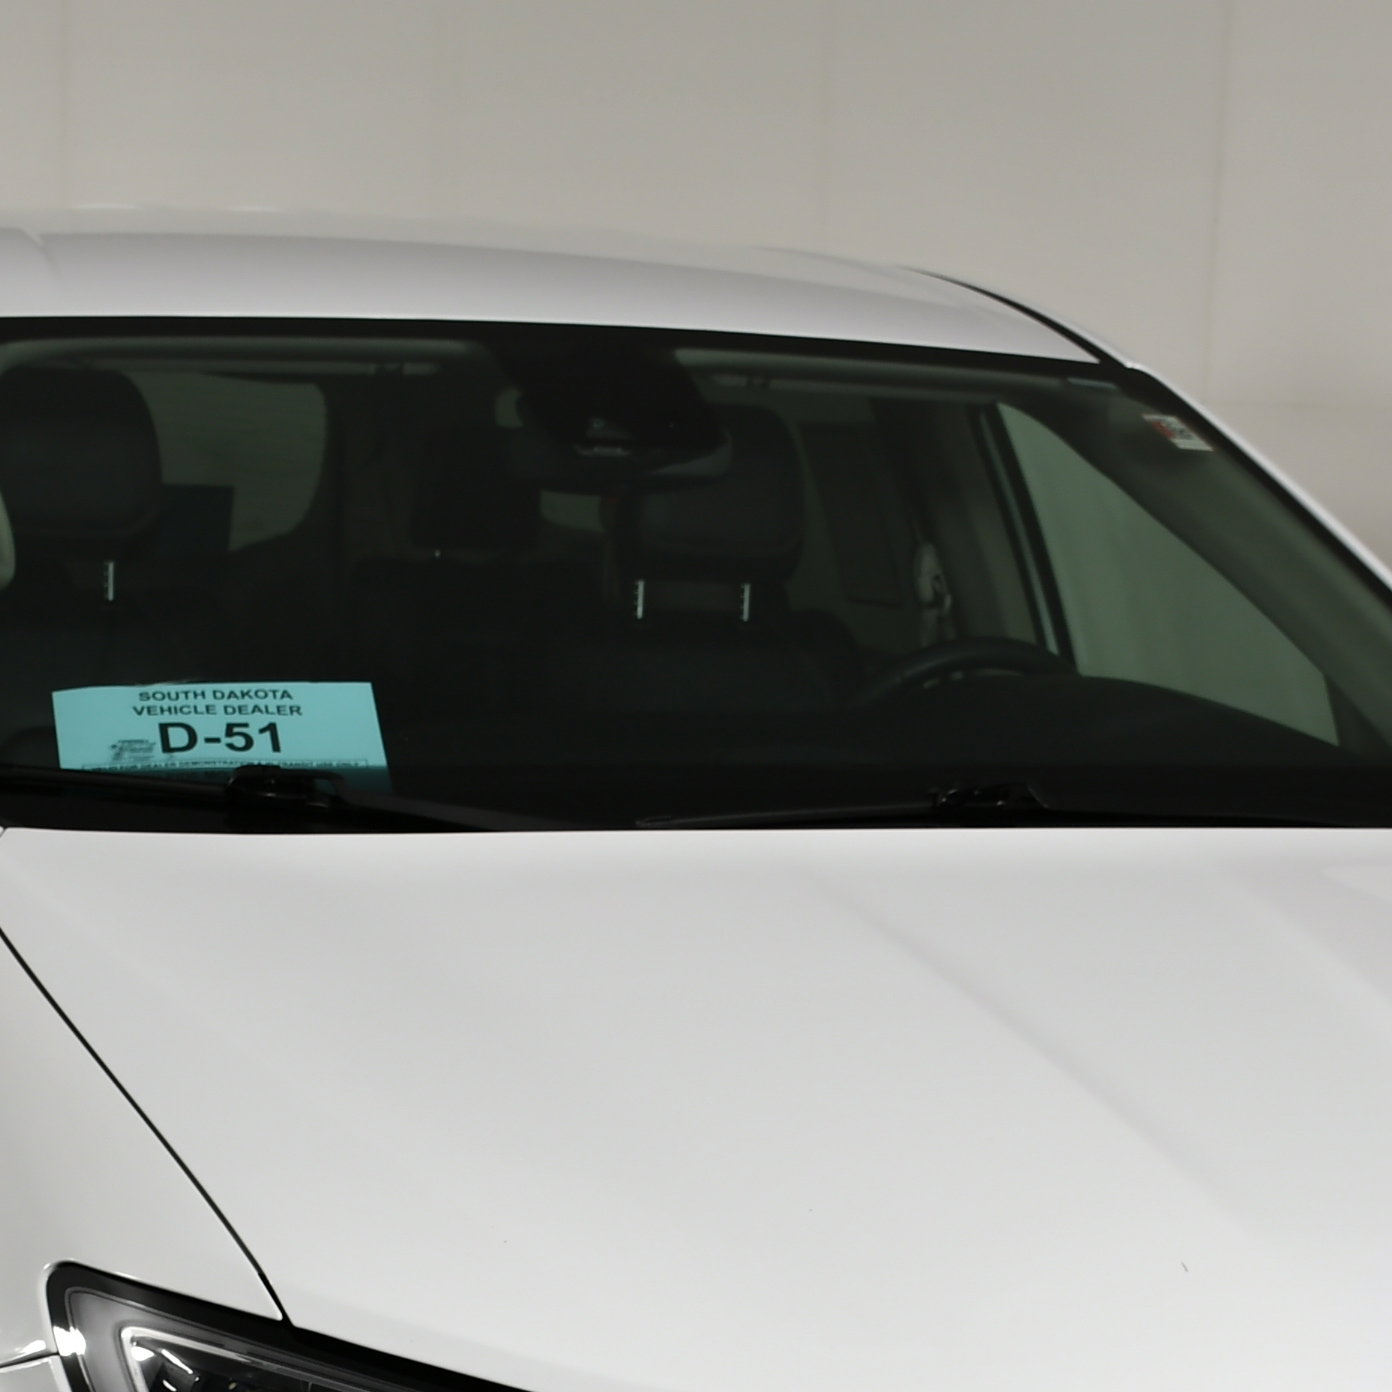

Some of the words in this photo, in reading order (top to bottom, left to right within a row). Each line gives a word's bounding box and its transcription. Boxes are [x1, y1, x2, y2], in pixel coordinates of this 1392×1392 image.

[138, 689, 206, 702] SOUTH
[212, 689, 294, 701] DAKOTA
[132, 704, 217, 716] VEHICLE
[223, 704, 303, 716] DEALER
[158, 721, 282, 754] D-51
